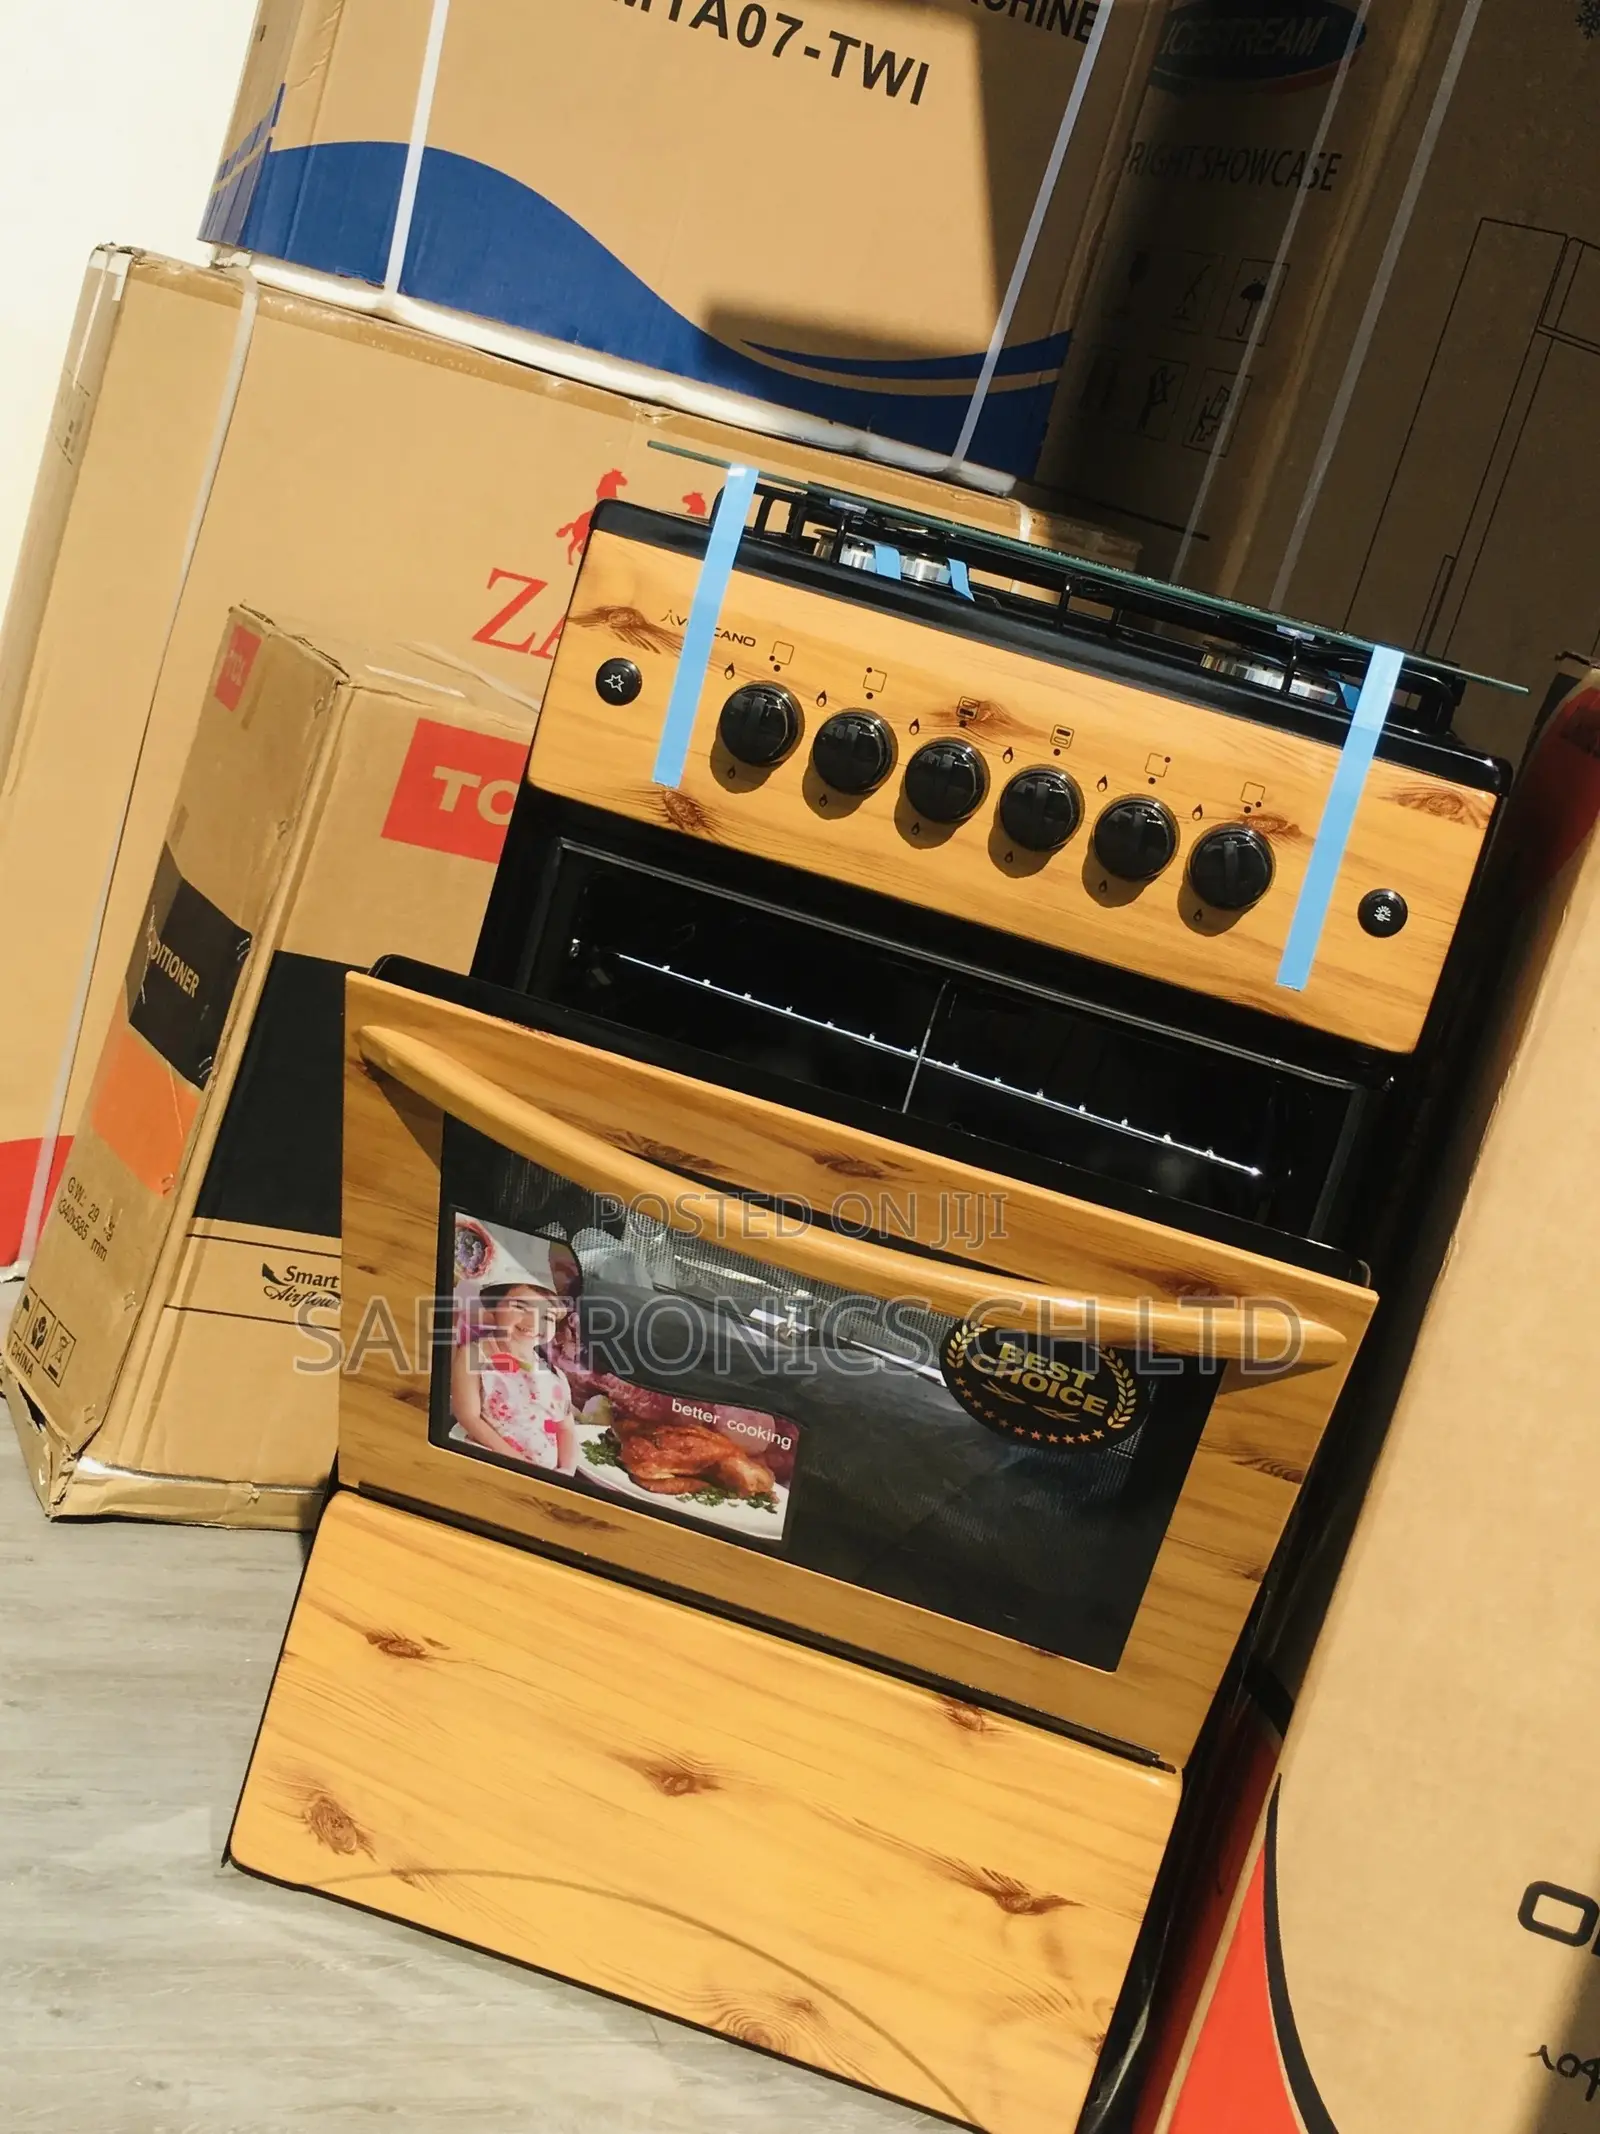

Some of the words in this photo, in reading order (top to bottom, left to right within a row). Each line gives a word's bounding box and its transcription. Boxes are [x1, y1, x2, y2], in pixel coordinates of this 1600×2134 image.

[88, 1203, 100, 1223] 29
[283, 1265, 340, 1289] Smart
[11, 1340, 34, 1379] CHINA
[1000, 1342, 1095, 1390] BEST
[971, 1353, 1108, 1417] CHOICE
[671, 1398, 720, 1425] better
[726, 1419, 792, 1450] cooking
